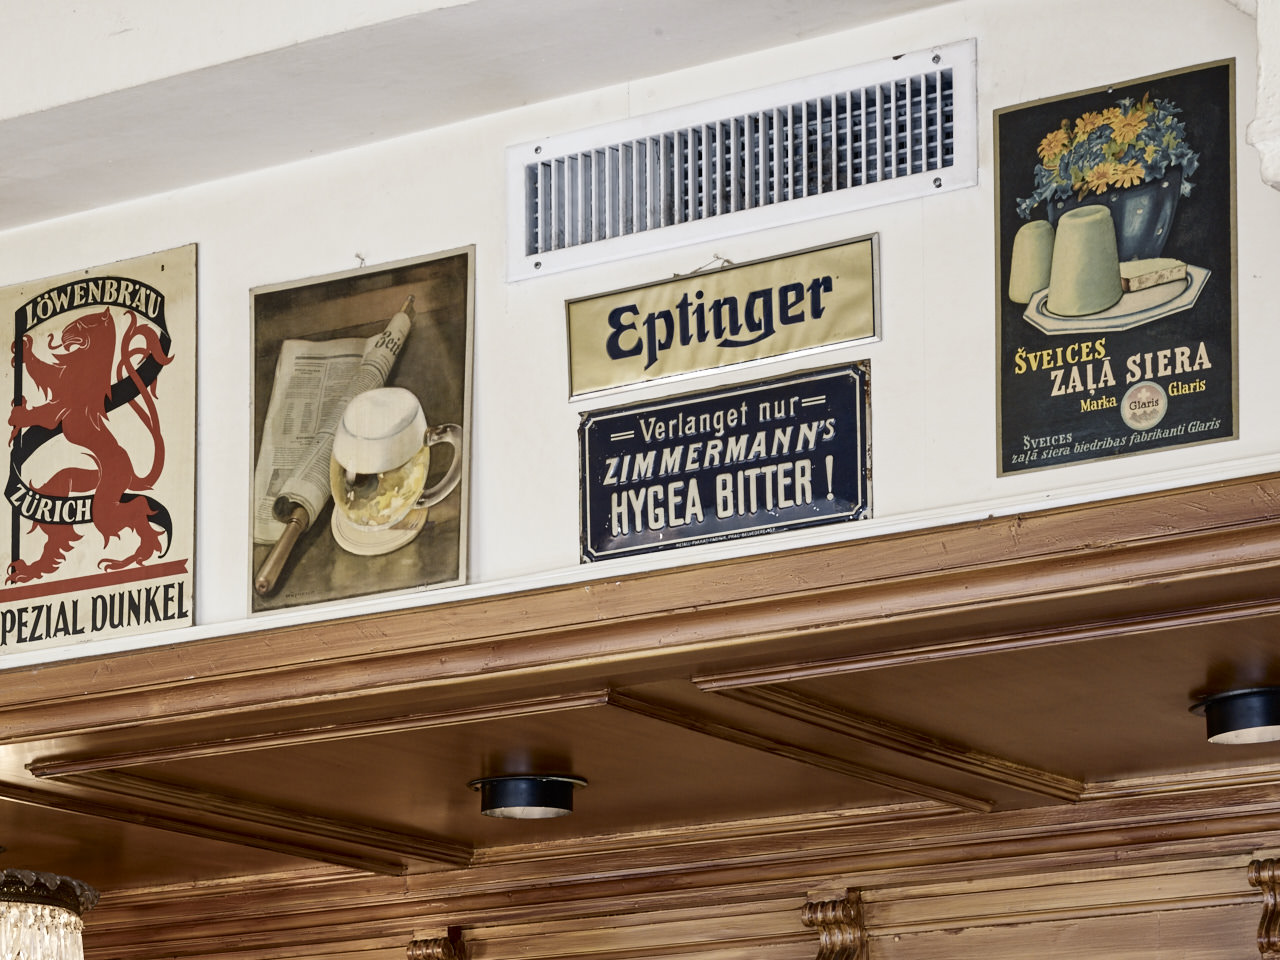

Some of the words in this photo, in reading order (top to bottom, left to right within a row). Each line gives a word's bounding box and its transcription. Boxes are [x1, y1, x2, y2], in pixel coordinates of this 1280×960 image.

[25, 279, 162, 330] LÖWENBRÄU
[606, 275, 833, 371] Eptinger
[1014, 337, 1106, 375] ŠVEICES
[1051, 356, 1116, 397] ZAĻĀ
[1125, 341, 1212, 385] SIERA
[1080, 395, 1118, 413] Marka
[1168, 378, 1207, 397] Glaris
[1129, 398, 1160, 412] Glaris
[640, 401, 748, 444] Verlanget
[759, 395, 800, 423] nur
[1023, 432, 1073, 450] ŠVEICES
[1041, 445, 1071, 460] siera
[1129, 423, 1186, 447] fabrikanti
[1187, 418, 1222, 434] Glaris
[9, 483, 93, 523] ZÜRICH
[611, 477, 704, 538] HYGEA
[715, 458, 812, 520] BITTER
[90, 580, 189, 633] DUNKEL
